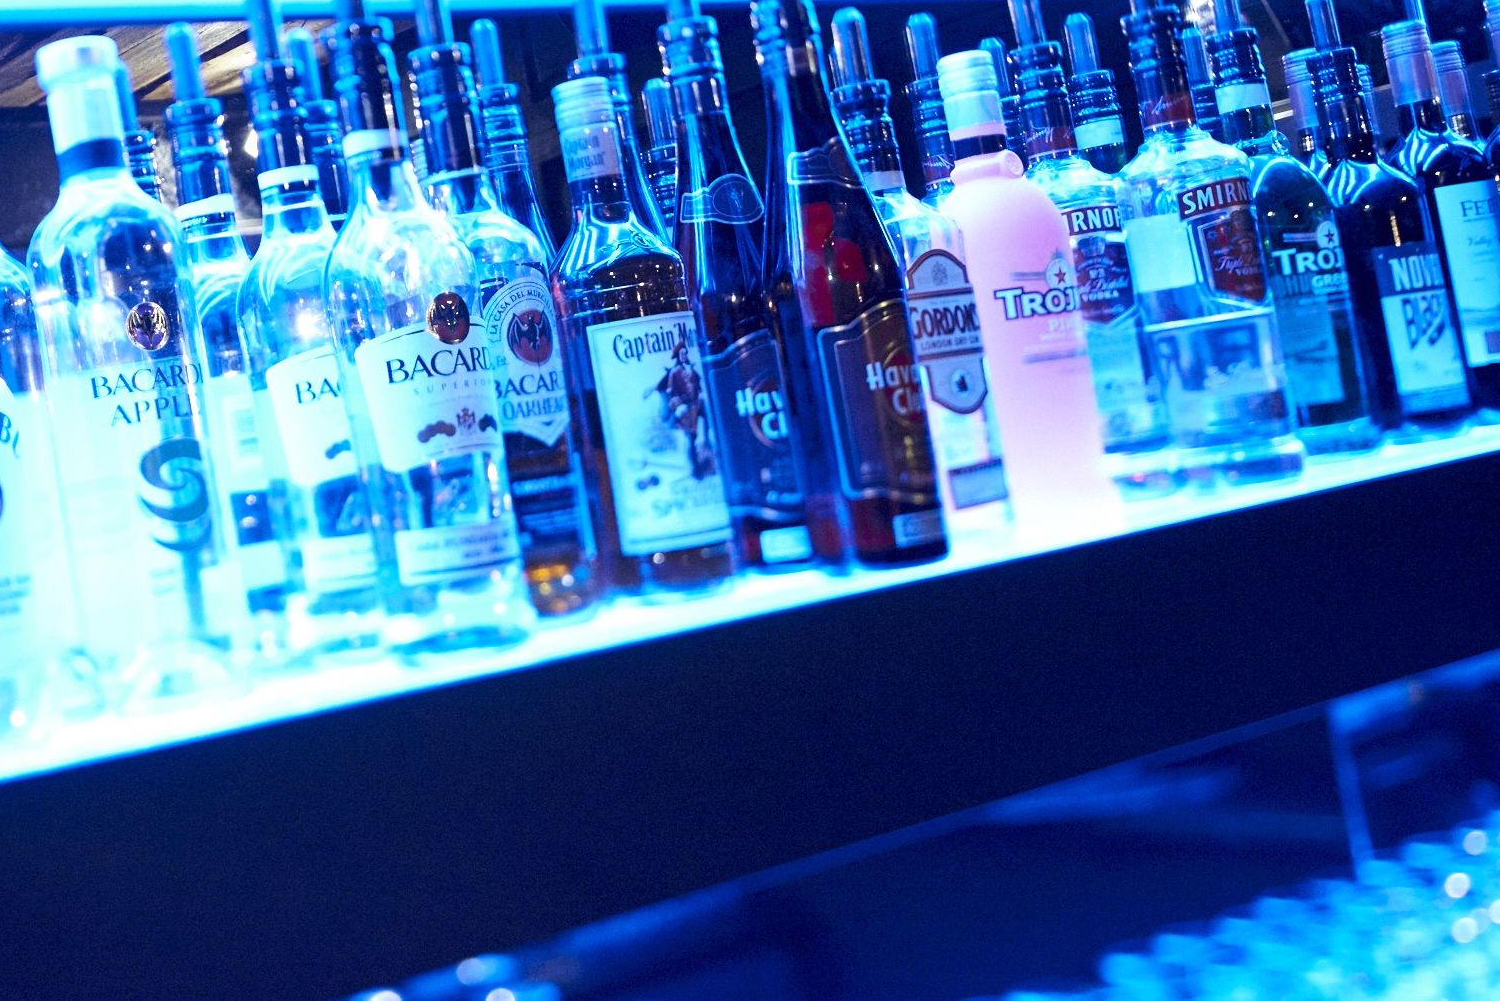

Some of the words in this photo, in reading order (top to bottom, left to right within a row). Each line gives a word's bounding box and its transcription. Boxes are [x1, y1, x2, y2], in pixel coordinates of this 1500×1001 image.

[493, 301, 510, 323] CASA
[510, 290, 525, 304] DEL
[613, 326, 675, 363] Captain
[91, 361, 204, 399] BACARDI
[494, 371, 562, 399] ACAR
